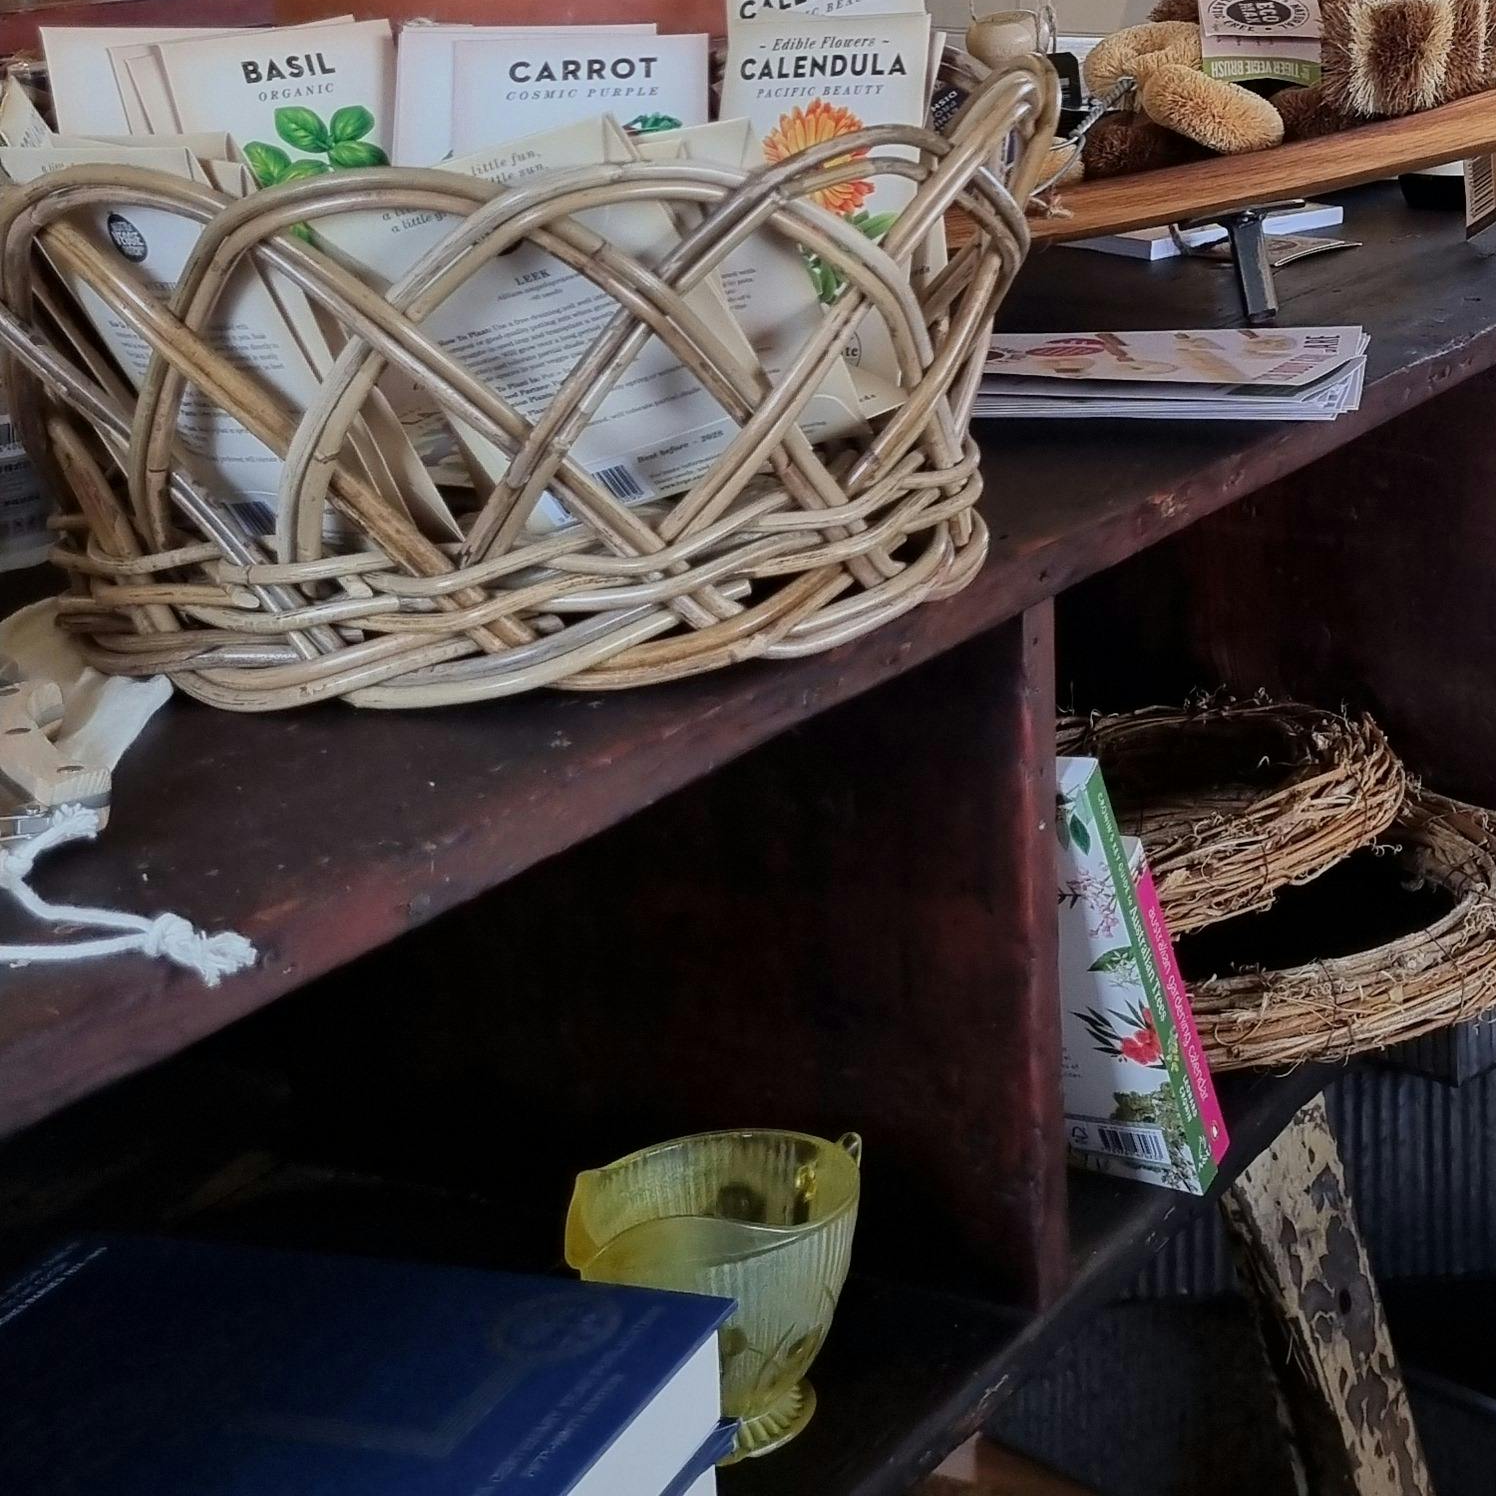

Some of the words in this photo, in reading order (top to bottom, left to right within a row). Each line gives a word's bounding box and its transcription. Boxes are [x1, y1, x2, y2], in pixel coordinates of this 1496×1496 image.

[772, 37, 815, 52] Edible
[819, 35, 876, 50] Flowers
[241, 52, 336, 84] BASIL
[509, 57, 658, 83] CARROT
[740, 52, 907, 81] CALENDULA
[1211, 60, 1244, 77] BRUSH
[1273, 61, 1300, 78] TIGER
[258, 83, 335, 102] ORGANIC
[505, 88, 578, 101] COSMIC
[587, 86, 660, 98] PURPLE
[756, 87, 817, 99] PACIFIC
[823, 84, 885, 96] BEAUTY
[471, 158, 506, 176] little
[514, 269, 551, 285] LEEK
[659, 442, 689, 456] before
[1129, 906, 1156, 984] Australian
[1150, 984, 1167, 1022] Trees
[1148, 908, 1171, 974] australian
[1167, 975, 1192, 1048] gardening
[1189, 1045, 1208, 1102] calendar
